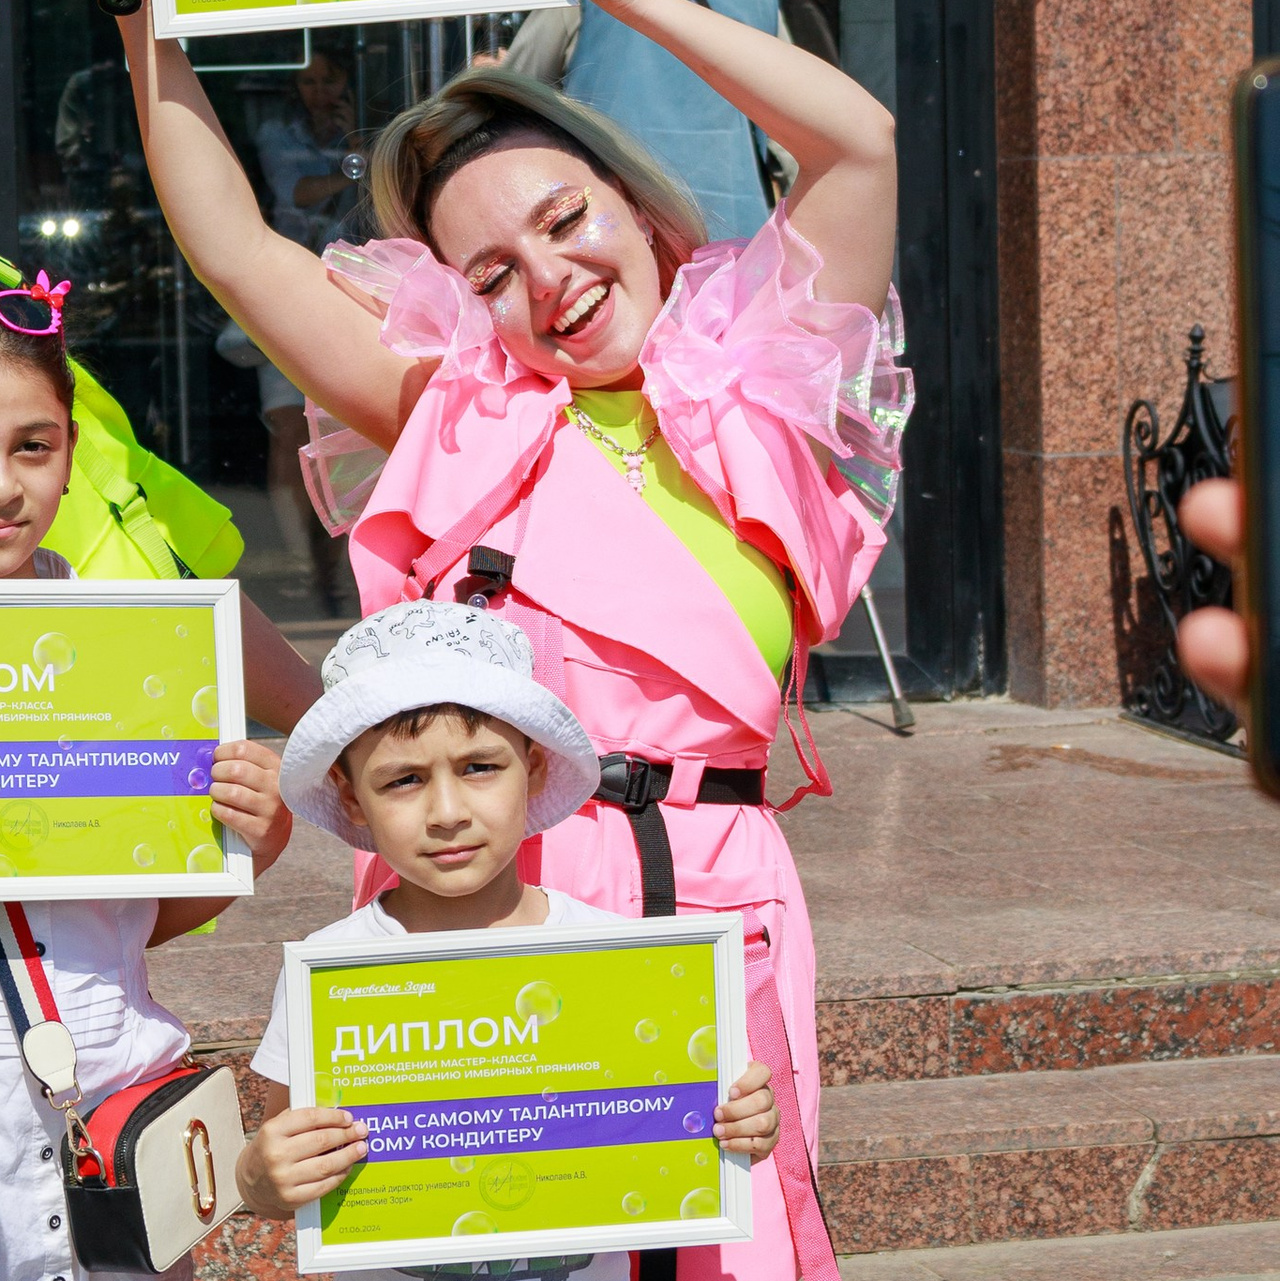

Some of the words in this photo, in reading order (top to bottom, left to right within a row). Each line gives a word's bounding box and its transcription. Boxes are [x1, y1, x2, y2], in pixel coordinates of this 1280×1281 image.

[53, 712, 112, 722] ПРЯНИКОВ
[28, 752, 181, 767] ТАЛАНТЛИВОМУ
[52, 820, 87, 828] Николаев
[329, 984, 401, 1001] Сормовские
[405, 981, 436, 997] Зори
[331, 1014, 539, 1062] ДИПЛОМ
[332, 1066, 341, 1074] О
[344, 1060, 438, 1074] ПРОХОЖДЕНИИ
[440, 1053, 537, 1068] МАСТЕР-КЛАССА
[333, 1078, 350, 1087] ПО
[353, 1070, 461, 1087] ДЕКОРИРОВАНИЮ
[464, 1066, 533, 1078] ИМБИРНЫХ
[536, 1061, 600, 1073] ПРЯНИКОВ
[360, 1114, 409, 1133] ДАН
[414, 1108, 505, 1129] САМОМУ
[509, 1096, 675, 1121] ТАЛАНТЛИВОМУ
[365, 1135, 416, 1153] ОМУ
[422, 1127, 544, 1150] КОНДИТЕРУ
[336, 1184, 387, 1197] Генеральный
[388, 1181, 423, 1194] директор
[424, 1179, 470, 1192] универмага
[536, 1173, 572, 1182] Николаев
[337, 1197, 389, 1209] «Сормовские
[389, 1195, 413, 1206] Зори»
[338, 1224, 381, 1234] 01.06.2024
